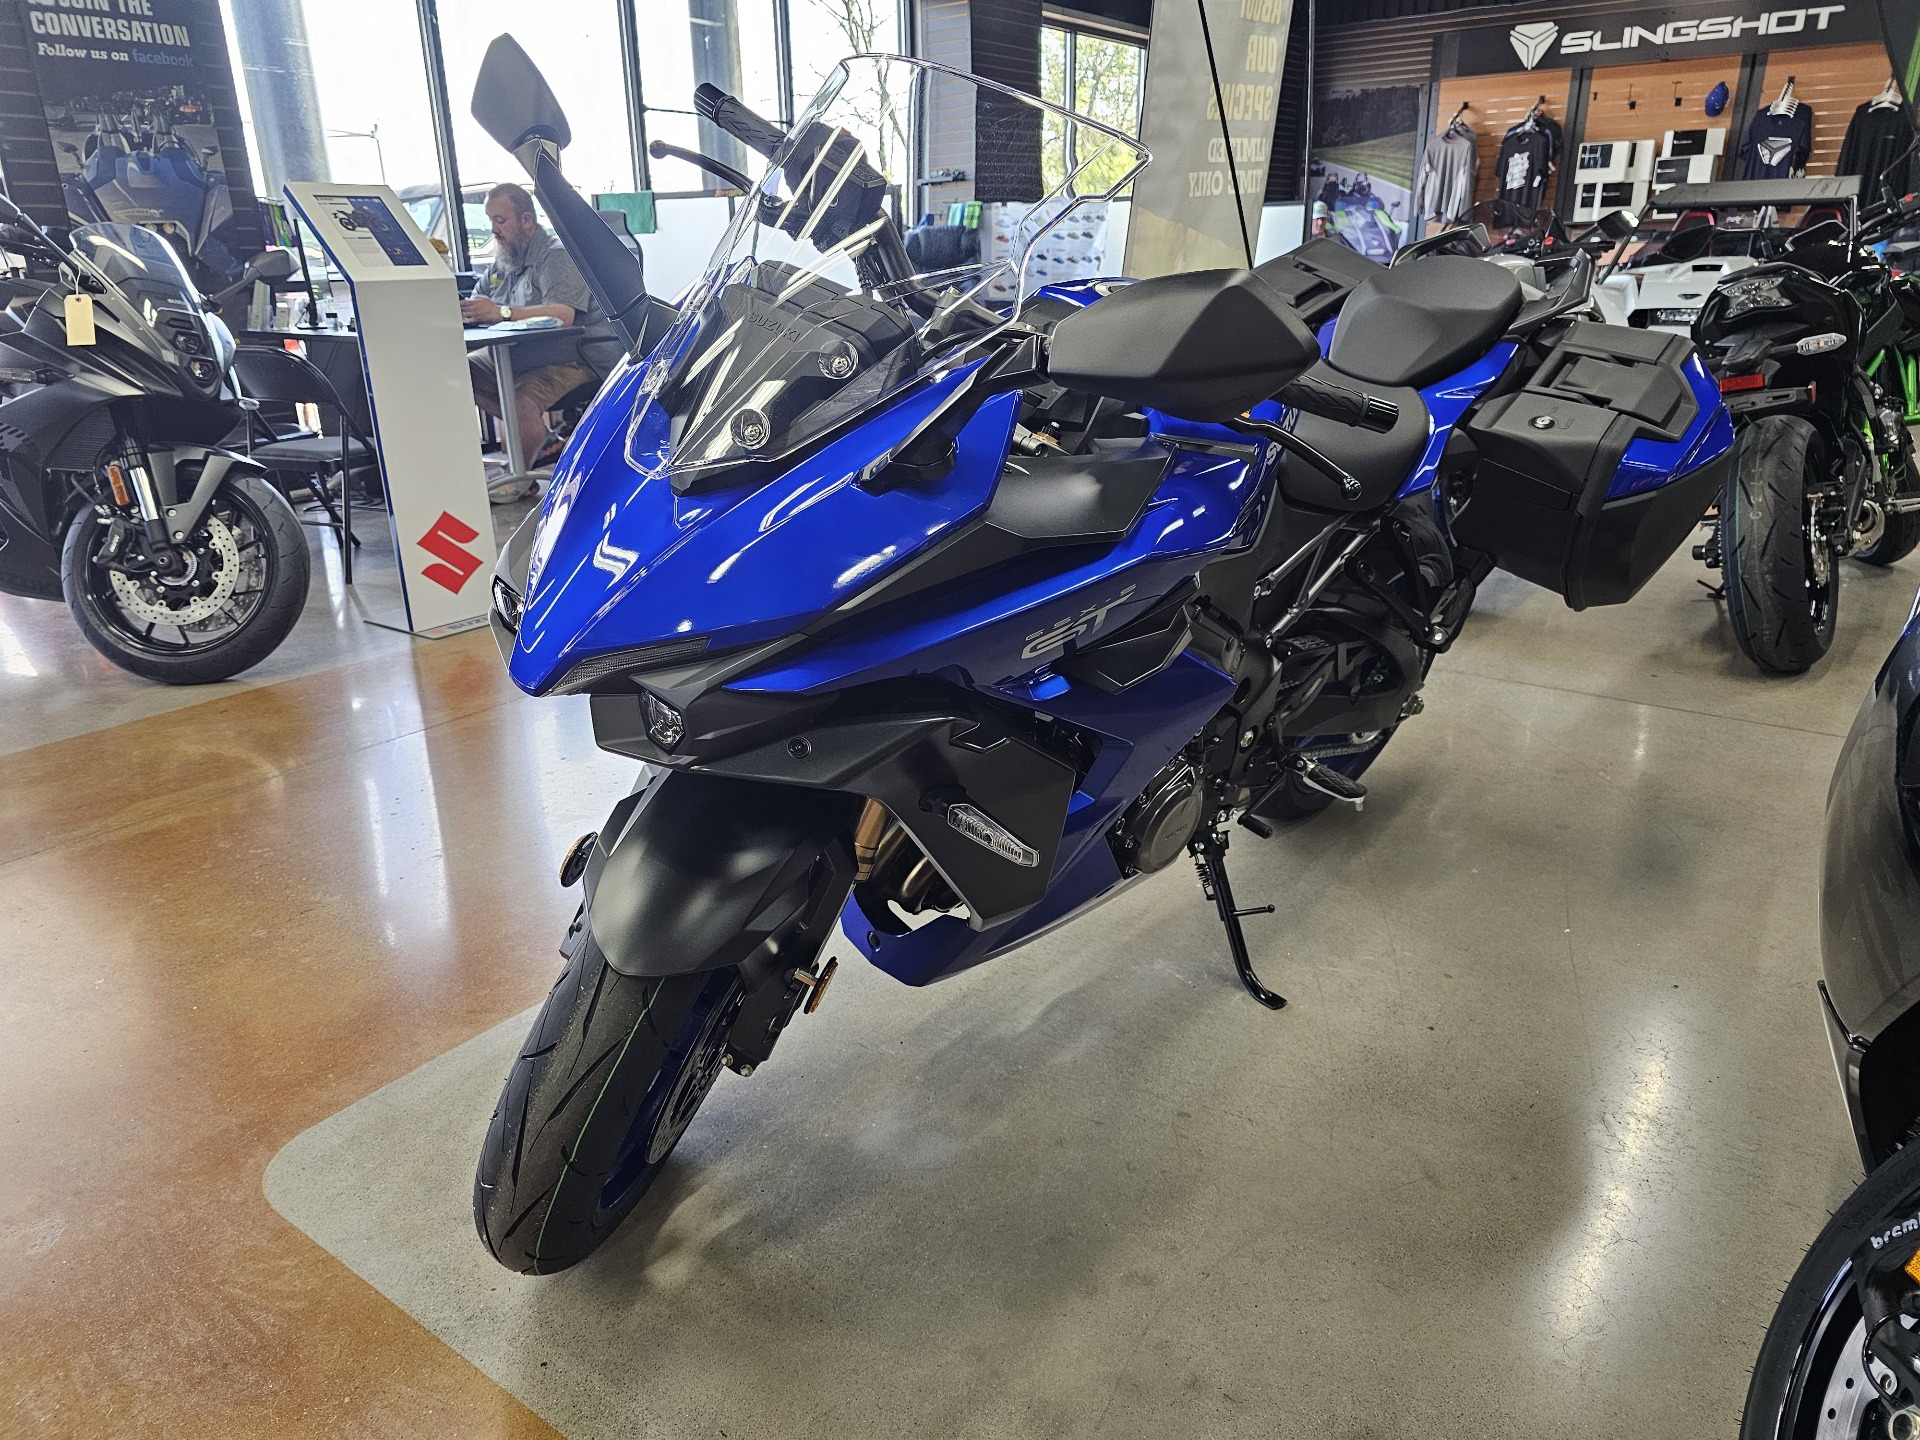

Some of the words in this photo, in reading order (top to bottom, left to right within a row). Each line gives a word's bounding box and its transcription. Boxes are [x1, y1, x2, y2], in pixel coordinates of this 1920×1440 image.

[118, 0, 154, 16] THE
[29, 10, 191, 47] CONVERSATION
[1560, 4, 1846, 54] SLINGSHOT
[37, 42, 87, 59] Follow
[91, 49, 108, 60] us
[111, 51, 130, 62] on
[132, 49, 194, 67] facebook
[748, 311, 802, 343] SUZUKI
[1869, 1211, 1920, 1250] brem
